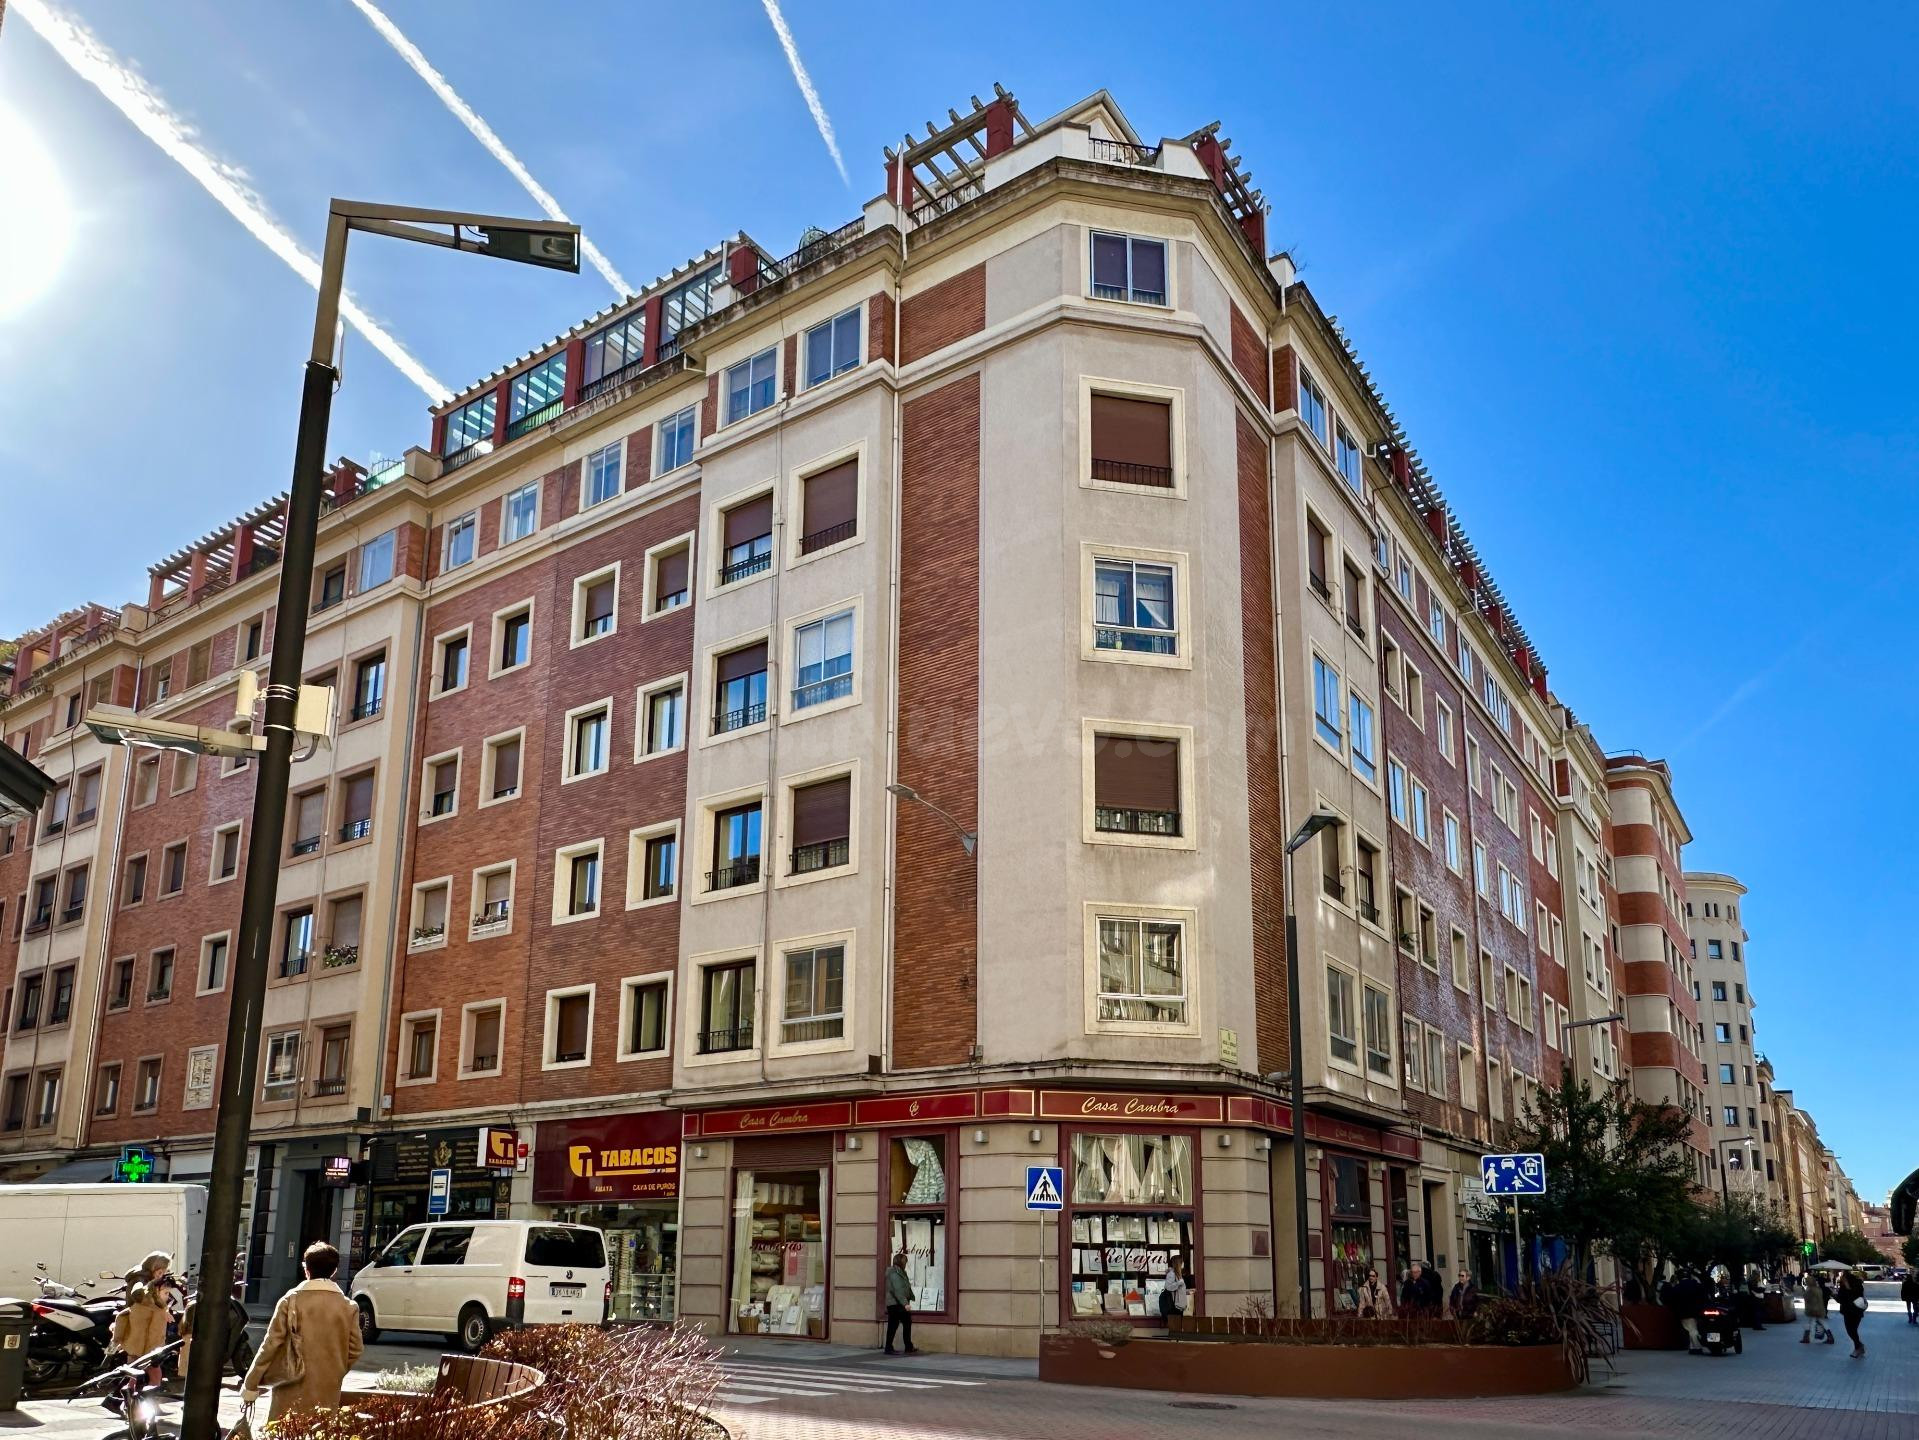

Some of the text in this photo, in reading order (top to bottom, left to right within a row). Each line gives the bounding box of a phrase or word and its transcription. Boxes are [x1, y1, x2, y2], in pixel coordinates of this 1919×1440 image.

[1081, 1096, 1179, 1115] Casa Cambra
[740, 1109, 808, 1128] Casa Cambra
[600, 1146, 677, 1168] TABACOS
